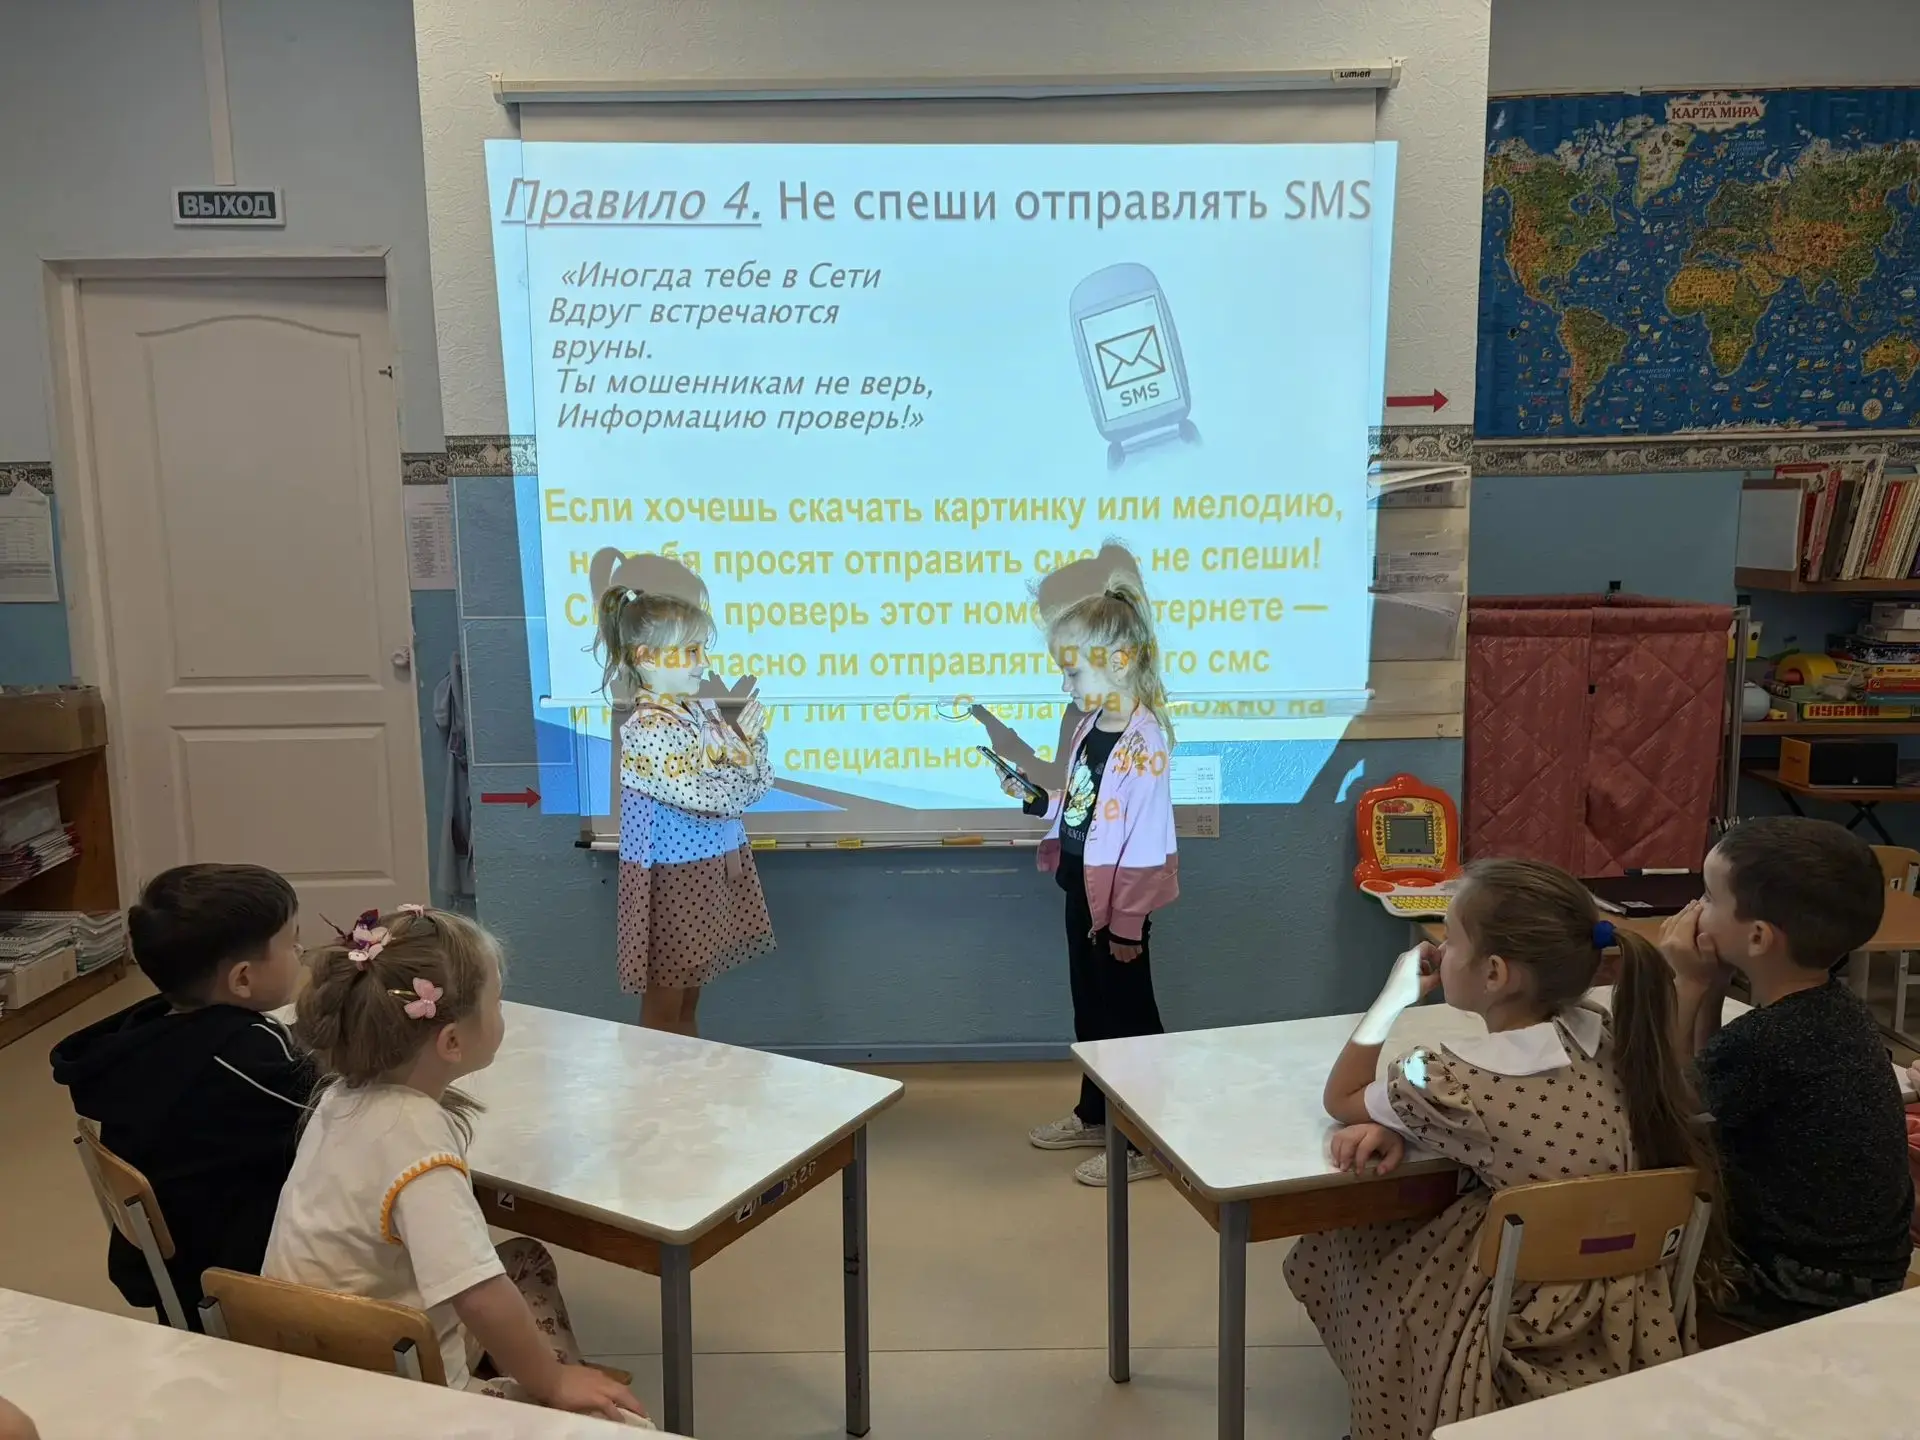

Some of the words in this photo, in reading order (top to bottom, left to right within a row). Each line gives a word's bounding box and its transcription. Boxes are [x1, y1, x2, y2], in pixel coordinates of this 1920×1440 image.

[1671, 107, 1717, 119] КАРТА
[1719, 106, 1760, 118] МИРА
[182, 194, 272, 217] ВЫХОД
[501, 177, 708, 229] Правило
[723, 180, 761, 222] 4.
[780, 181, 835, 221] Не
[855, 190, 996, 221] спеши
[1015, 190, 1267, 229] отправлять
[1284, 180, 1371, 220] SMS
[561, 261, 692, 292] «Иногда
[704, 260, 771, 288] тебе
[782, 269, 797, 289] в
[809, 263, 881, 289] Сети
[549, 298, 641, 329] Вдруг
[649, 303, 839, 329] встречаются
[552, 339, 653, 364] вруны.
[557, 369, 596, 394] Ты
[606, 374, 804, 395] мошенникам
[815, 375, 849, 395] не
[861, 376, 933, 401] верь,
[1120, 382, 1160, 408] SMS
[557, 404, 766, 434] Информацию
[776, 405, 924, 434] проверь!»
[545, 489, 632, 523] Если
[644, 498, 778, 523] хочешь
[789, 497, 922, 523] скачать
[934, 497, 1086, 530] картинку
[1098, 496, 1160, 521] или
[1174, 493, 1342, 523] мелодию,
[714, 551, 835, 582] просят
[845, 549, 1022, 582] отправить
[1152, 547, 1190, 572] не
[1202, 537, 1321, 571] спеши!
[725, 602, 869, 633] проверь
[881, 602, 953, 626] этот
[816, 653, 859, 677] ли
[1208, 649, 1270, 674] смс
[1662, 1229, 1681, 1257] 2
